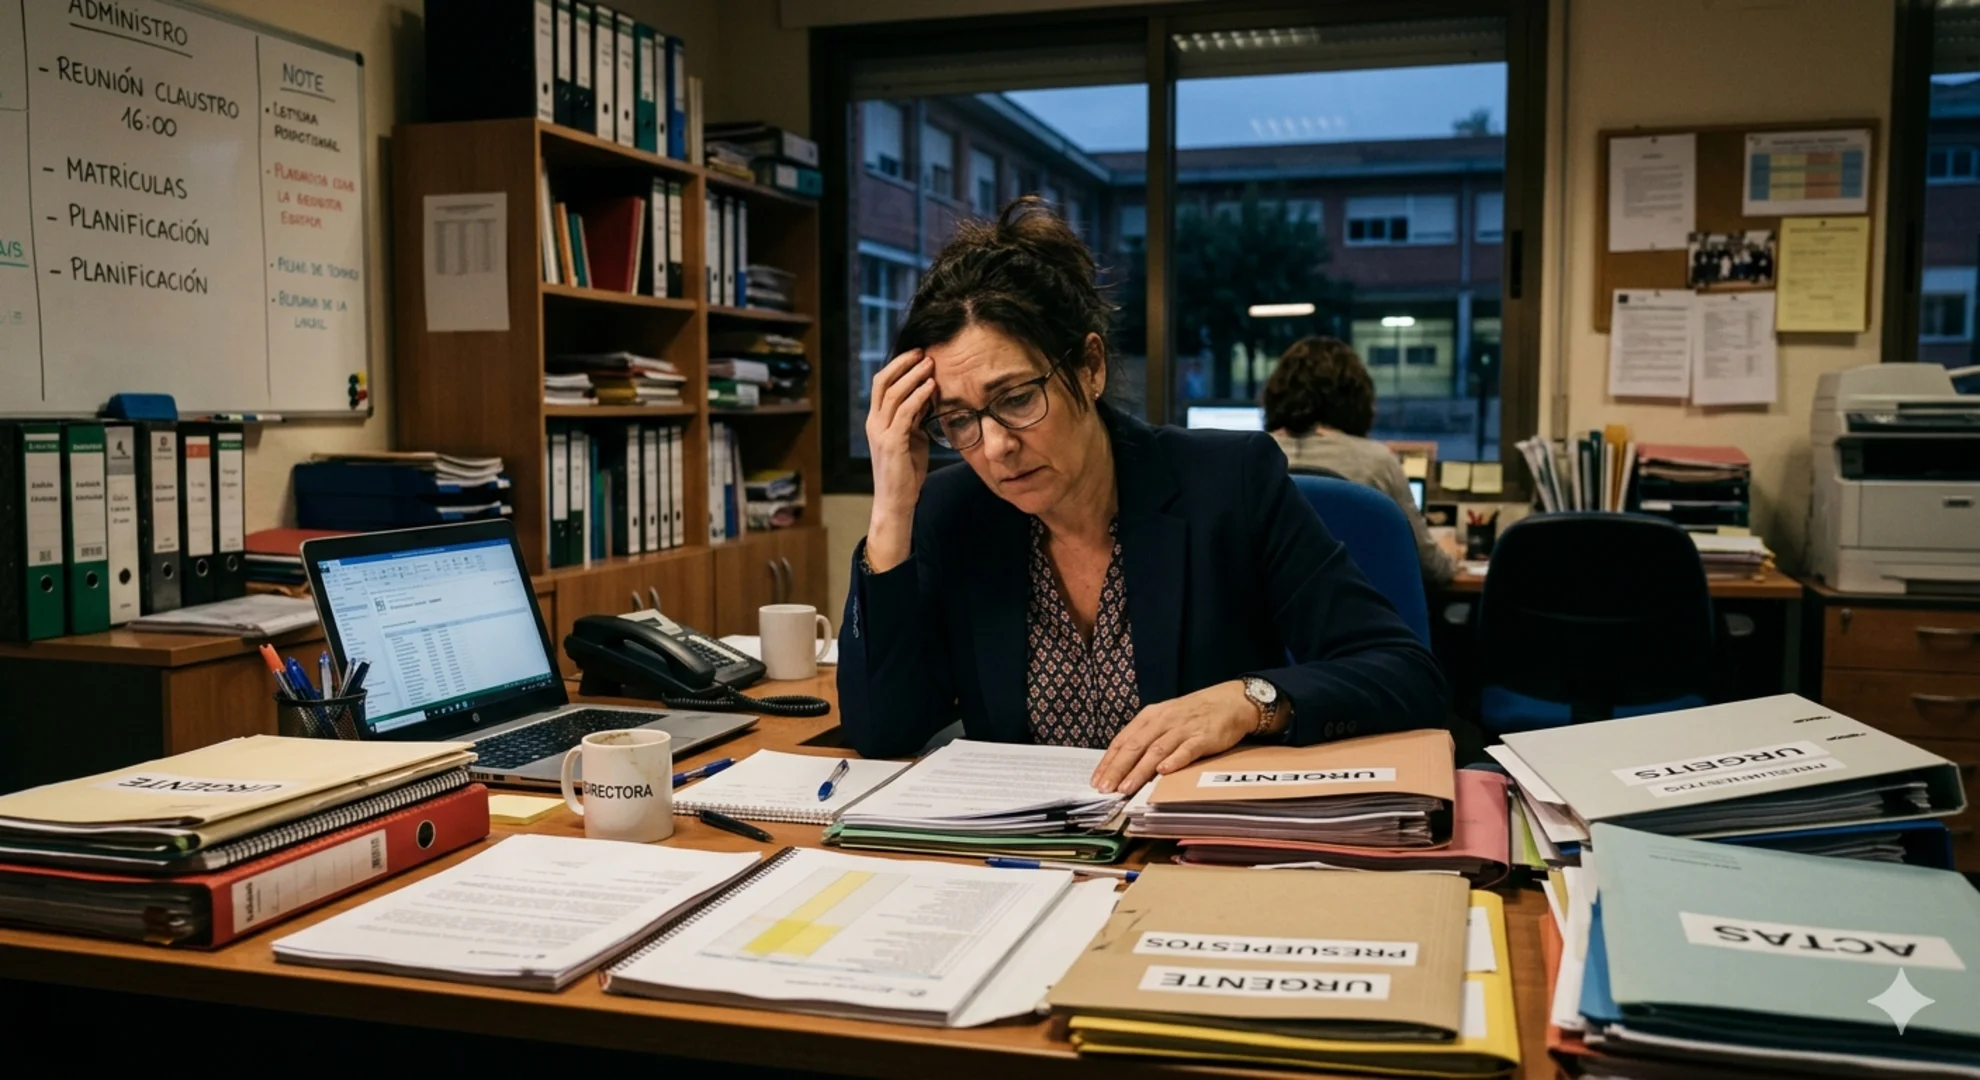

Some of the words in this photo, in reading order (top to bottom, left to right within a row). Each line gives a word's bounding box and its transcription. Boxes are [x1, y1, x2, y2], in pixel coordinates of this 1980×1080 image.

[57, 55, 144, 98] REUNIÓN
[155, 82, 240, 119] CLAUSTRO
[281, 63, 325, 93] NOTE
[121, 106, 178, 137] 16:00
[68, 203, 209, 246] PLANIFICACIÓN
[70, 256, 208, 295] PLANIFICACIÓN
[118, 776, 284, 793] URGENTE
[1712, 924, 1917, 958] ACTAS
[1162, 973, 1374, 993] URGENTE
